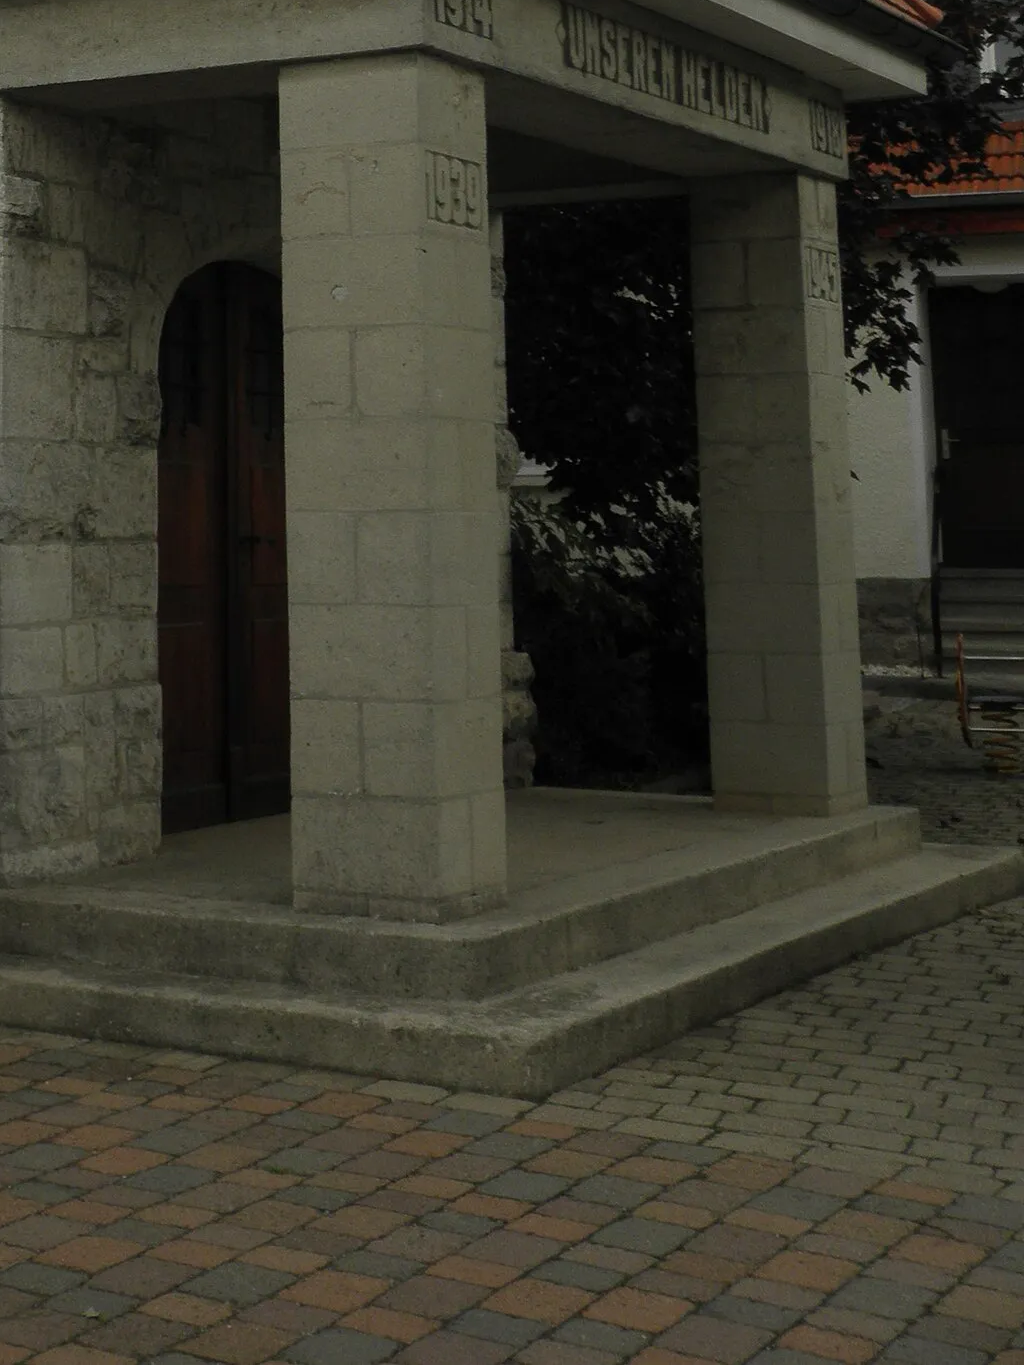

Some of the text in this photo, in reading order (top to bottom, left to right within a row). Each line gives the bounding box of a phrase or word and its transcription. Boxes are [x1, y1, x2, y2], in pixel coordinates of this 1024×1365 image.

[564, 3, 770, 134] UNSEREN HELDEN
[809, 101, 843, 159] 1918
[425, 150, 482, 231] 1939
[807, 247, 839, 303] 1945
